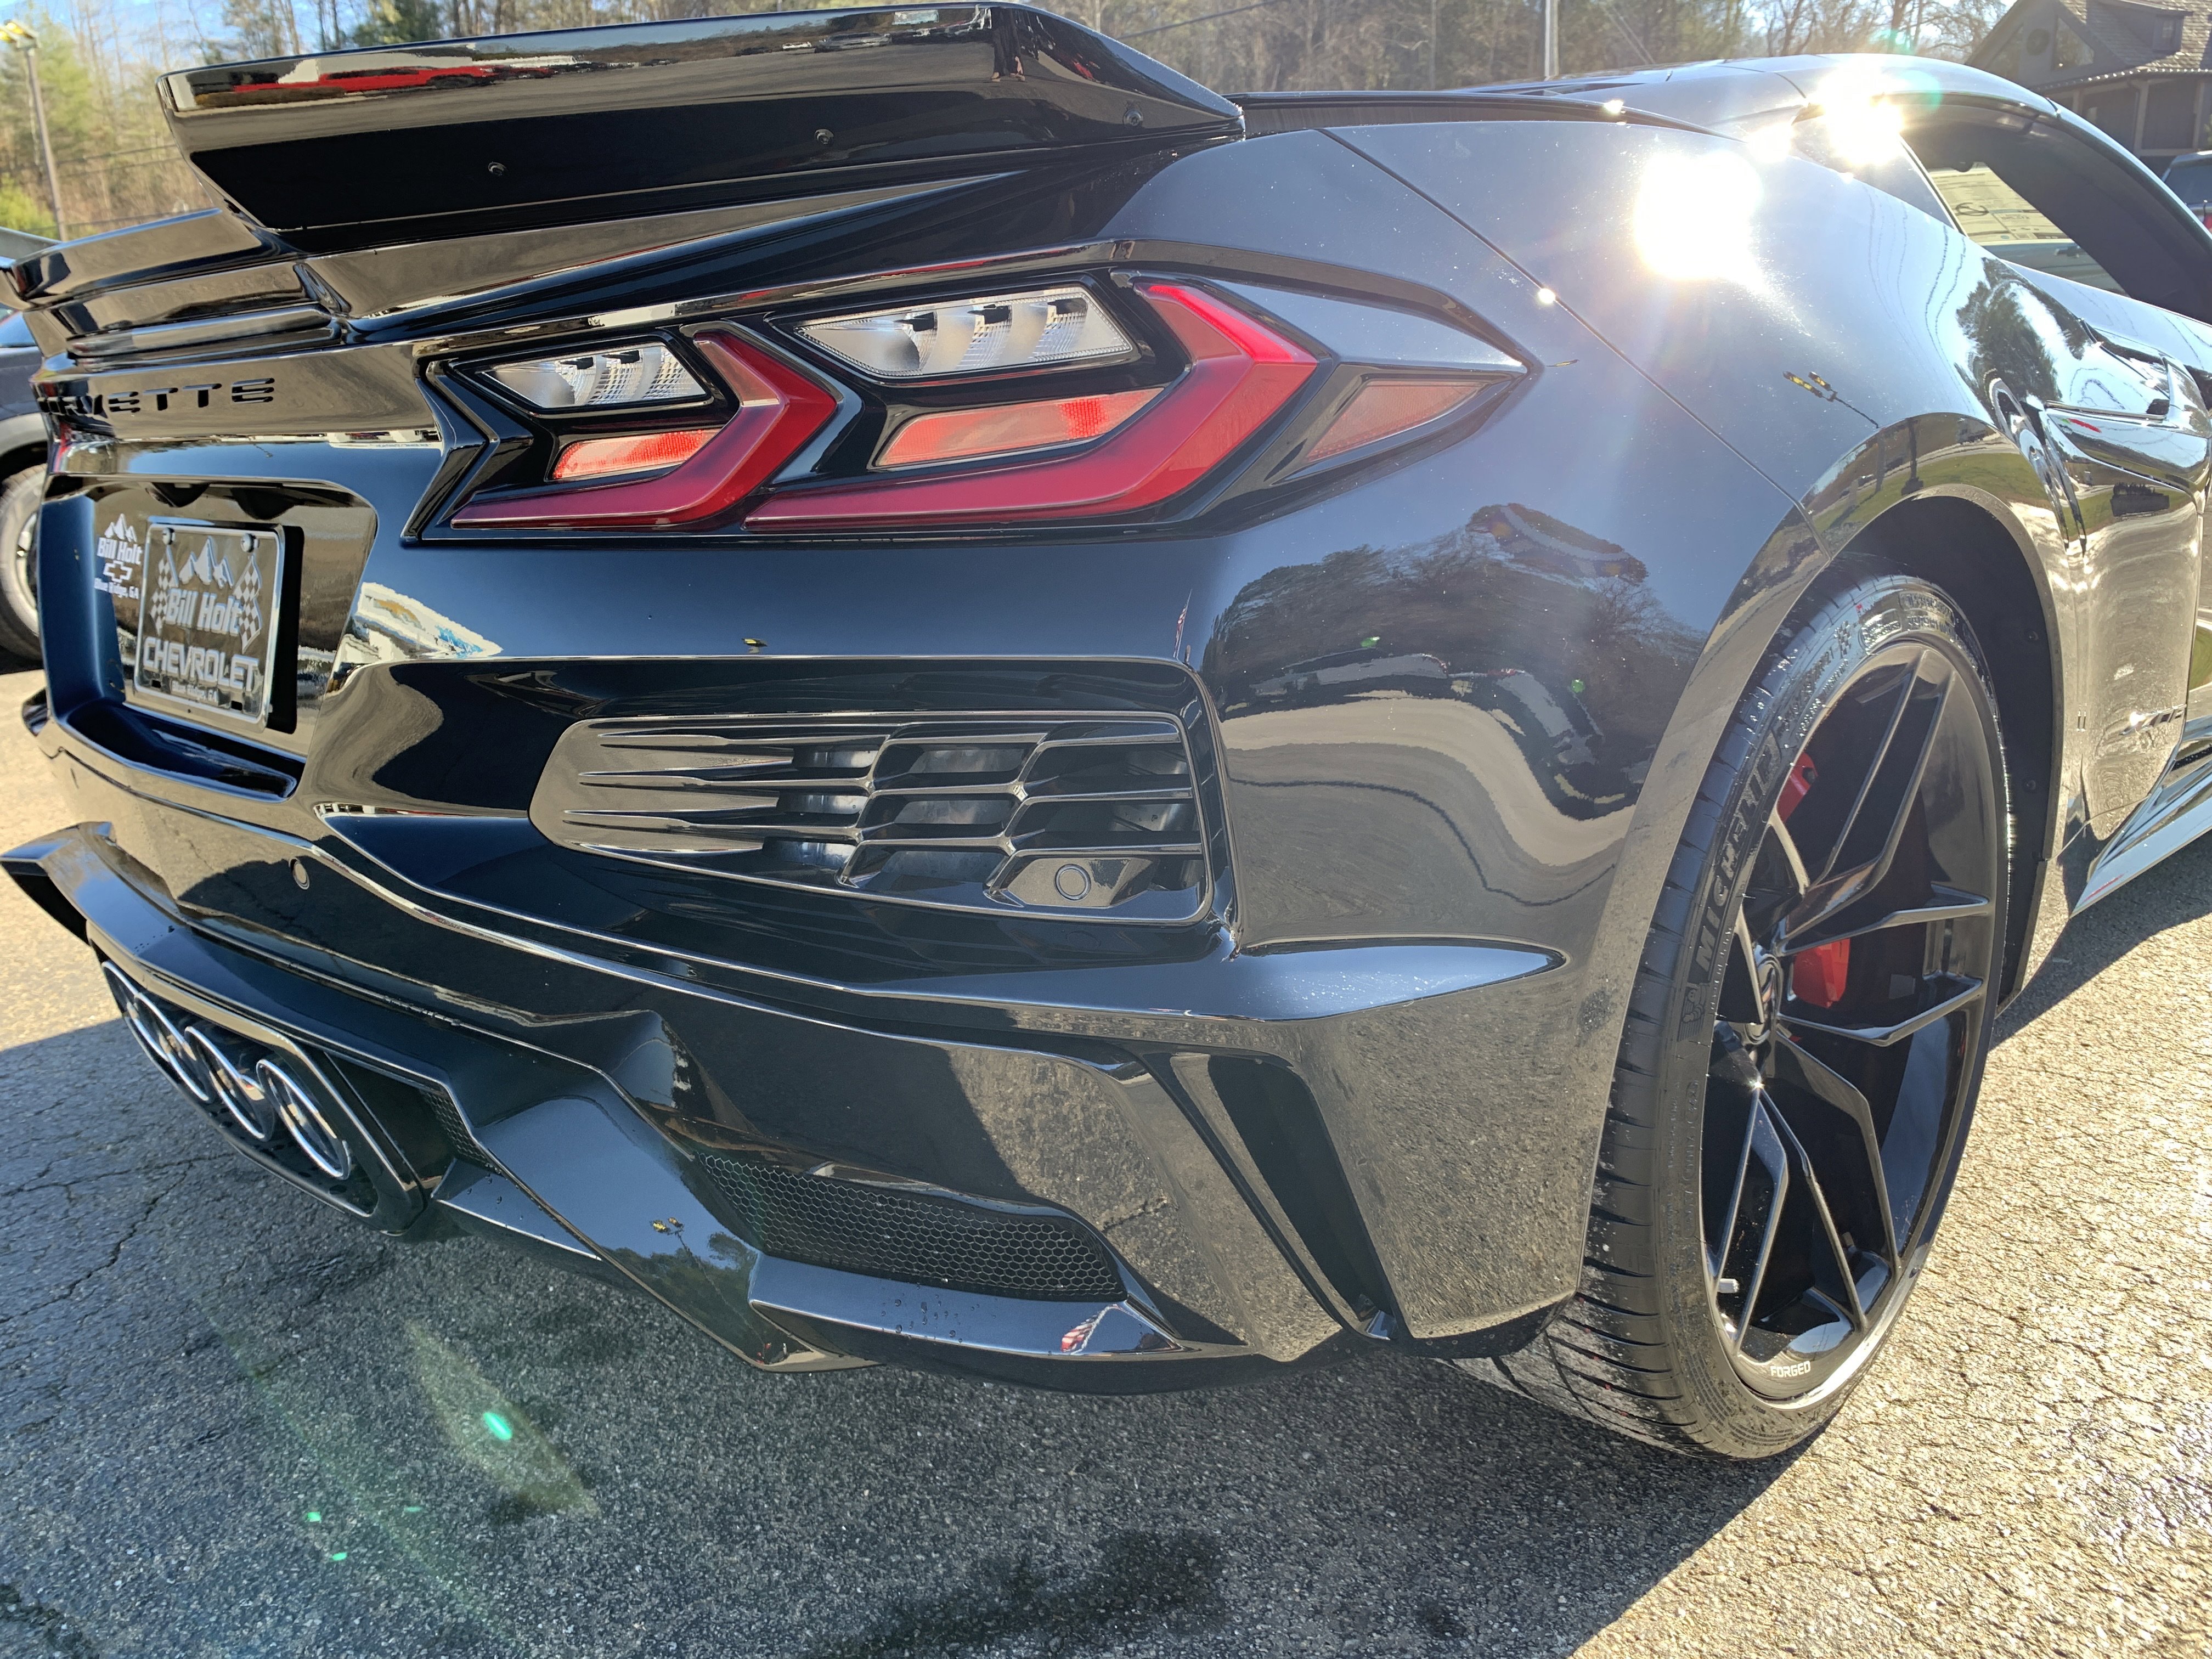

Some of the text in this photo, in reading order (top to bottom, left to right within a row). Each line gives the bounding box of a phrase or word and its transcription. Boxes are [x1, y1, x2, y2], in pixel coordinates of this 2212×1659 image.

[97, 537, 143, 565] Bill Holt
[166, 588, 244, 636] Bill Holt
[143, 636, 260, 693] CHEVROLET
[1770, 1361, 1811, 1378] FORGED
